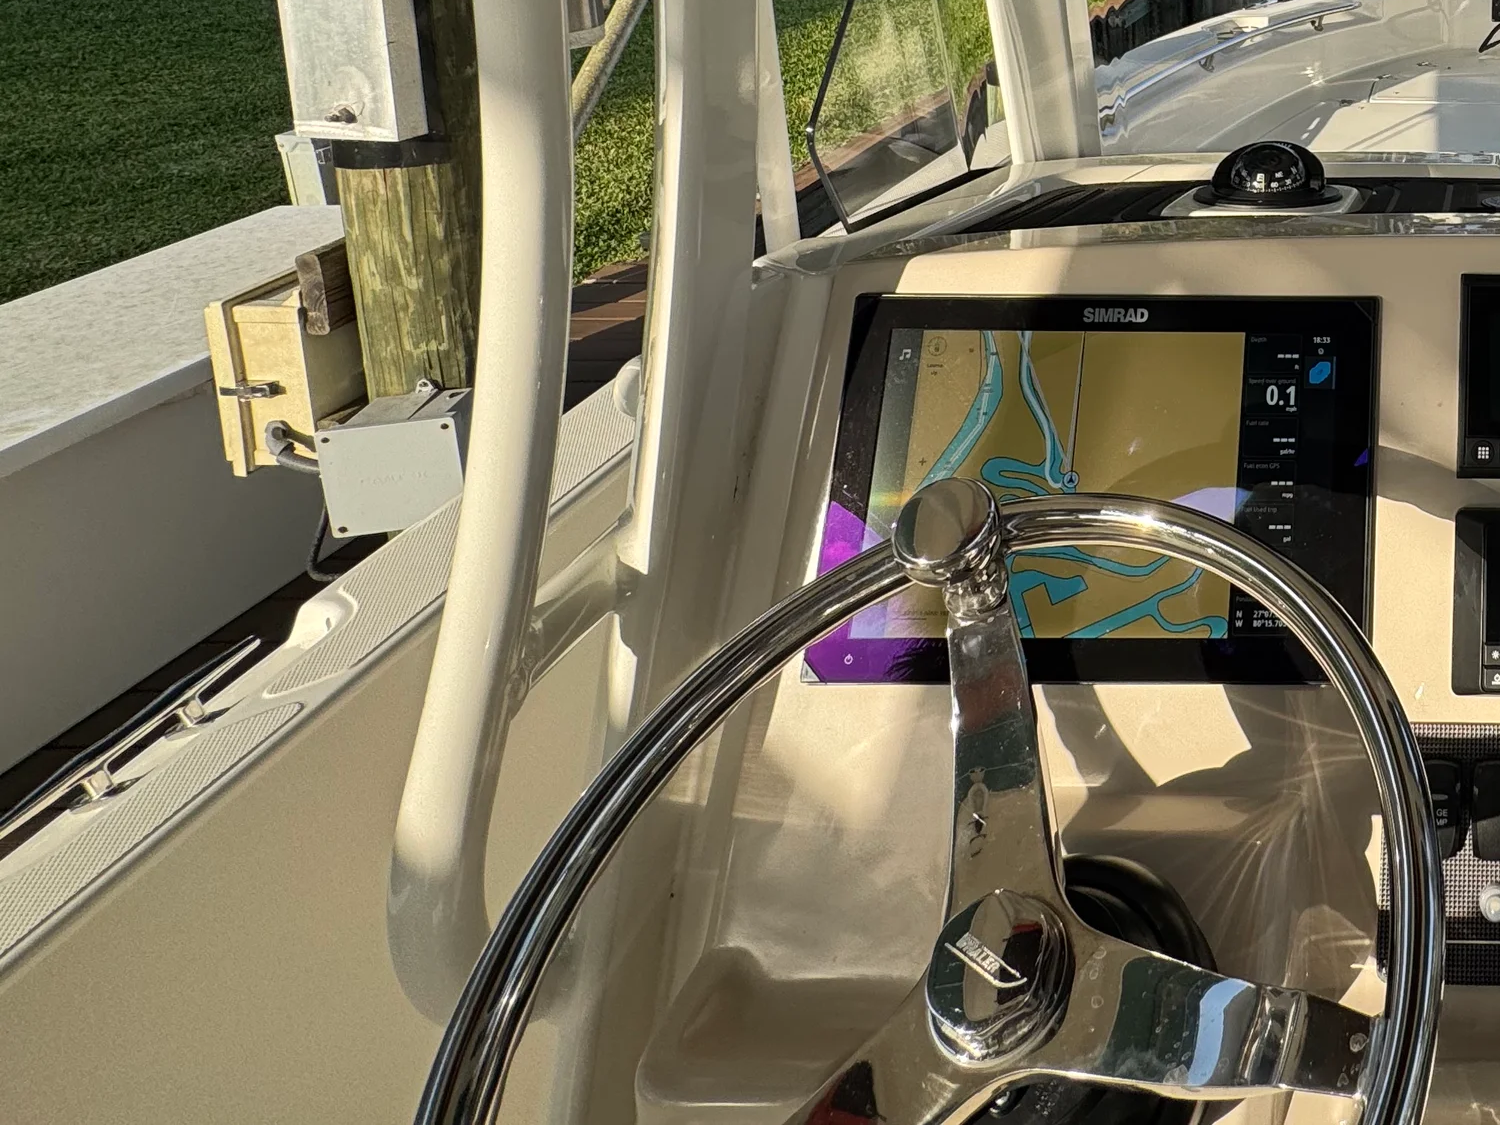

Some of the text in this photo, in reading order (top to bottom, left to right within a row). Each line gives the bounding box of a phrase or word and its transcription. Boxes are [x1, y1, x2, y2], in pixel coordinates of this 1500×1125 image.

[1083, 308, 1149, 323] SIMRAD
[1266, 385, 1296, 406] 0.1
[1236, 610, 1243, 618] N
[1235, 619, 1243, 628] W
